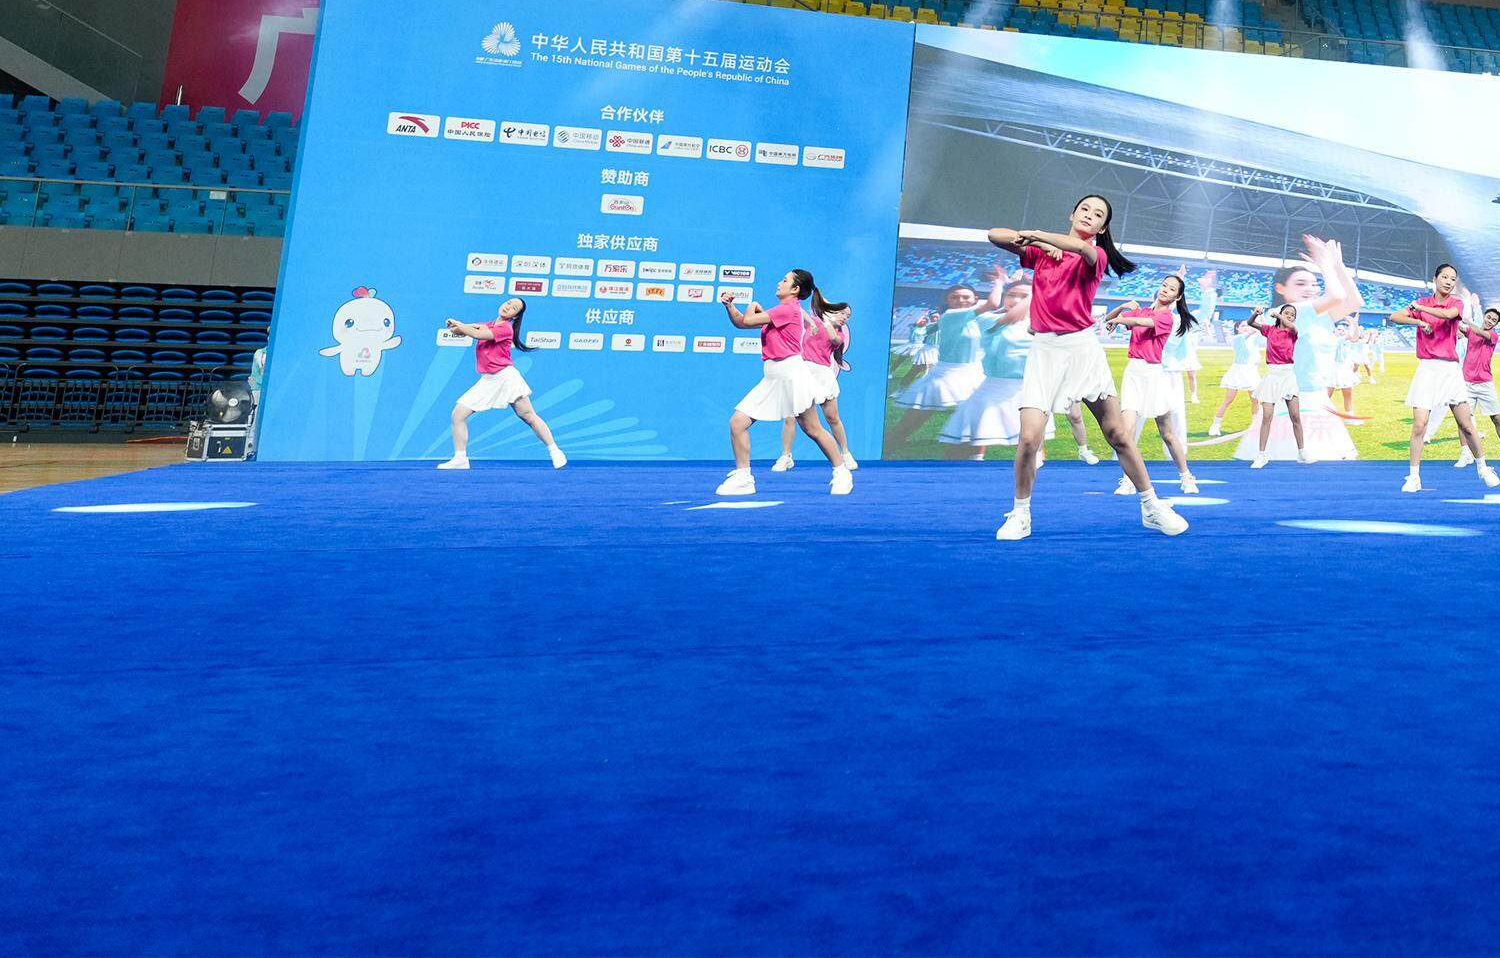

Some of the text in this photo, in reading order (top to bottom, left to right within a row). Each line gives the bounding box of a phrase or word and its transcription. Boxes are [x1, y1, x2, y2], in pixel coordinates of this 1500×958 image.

[531, 32, 790, 74] 中华人民共和国第十五届运动会
[531, 52, 548, 62] The
[552, 54, 572, 64] 15th
[575, 57, 613, 68] National
[616, 61, 647, 72] Games
[649, 64, 659, 73] of
[661, 65, 675, 75] the
[677, 68, 713, 79] People's
[715, 71, 753, 82] Republic
[754, 74, 763, 83] of
[765, 76, 790, 86] China
[600, 104, 664, 125] 合作伙伴
[396, 124, 417, 134] ANTA
[461, 121, 480, 130] PICC
[709, 145, 732, 154] ICBC
[601, 168, 649, 186] 赞助商
[577, 233, 659, 252] 独家供应商
[585, 308, 635, 326] 供应商
